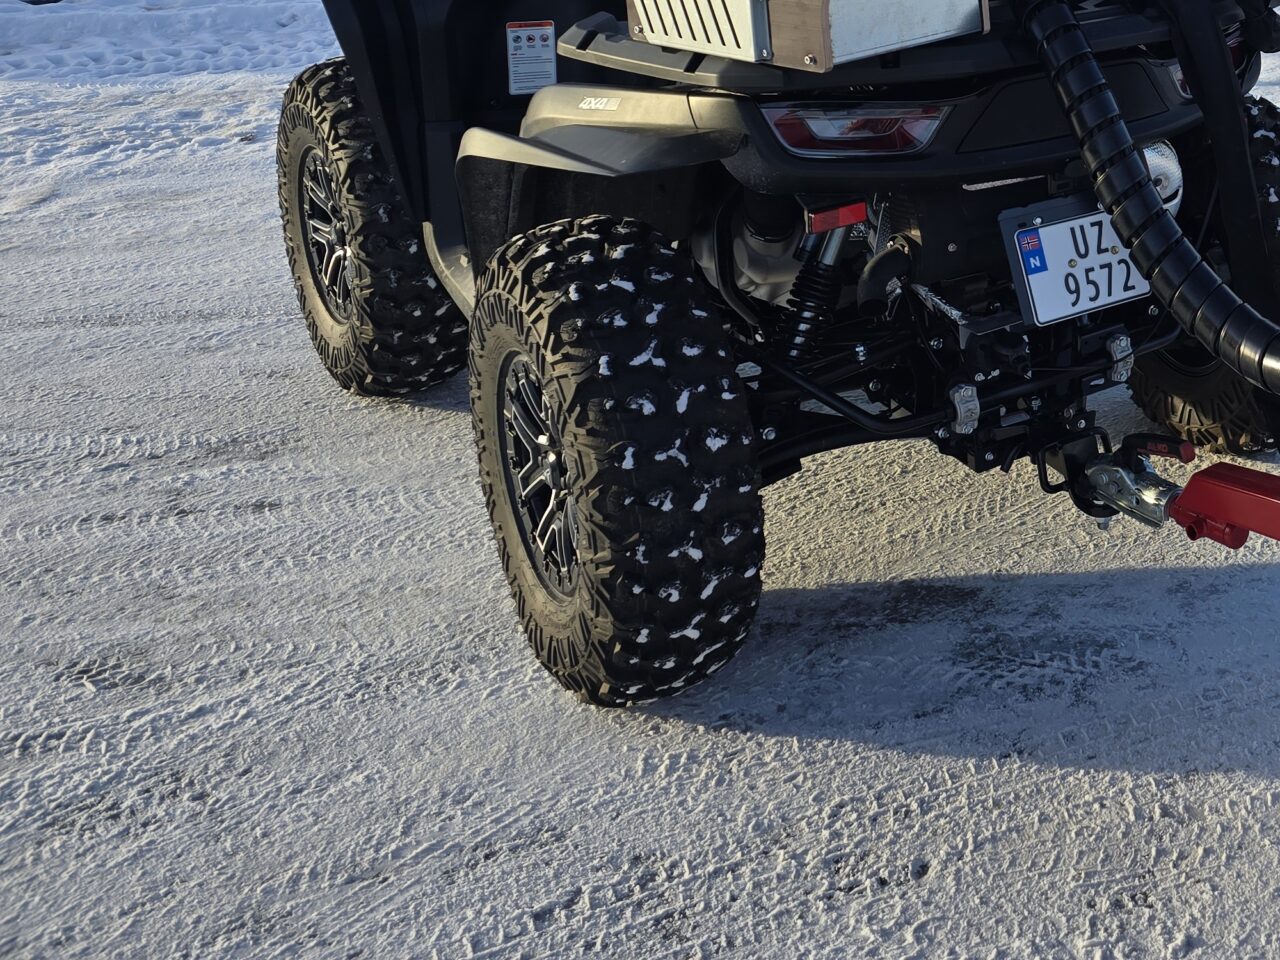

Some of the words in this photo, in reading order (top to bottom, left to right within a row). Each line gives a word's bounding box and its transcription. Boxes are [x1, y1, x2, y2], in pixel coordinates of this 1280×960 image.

[578, 97, 609, 110] 4X4
[1069, 219, 1110, 260] UZ
[1029, 255, 1041, 269] N
[1064, 258, 1136, 307] 9572
